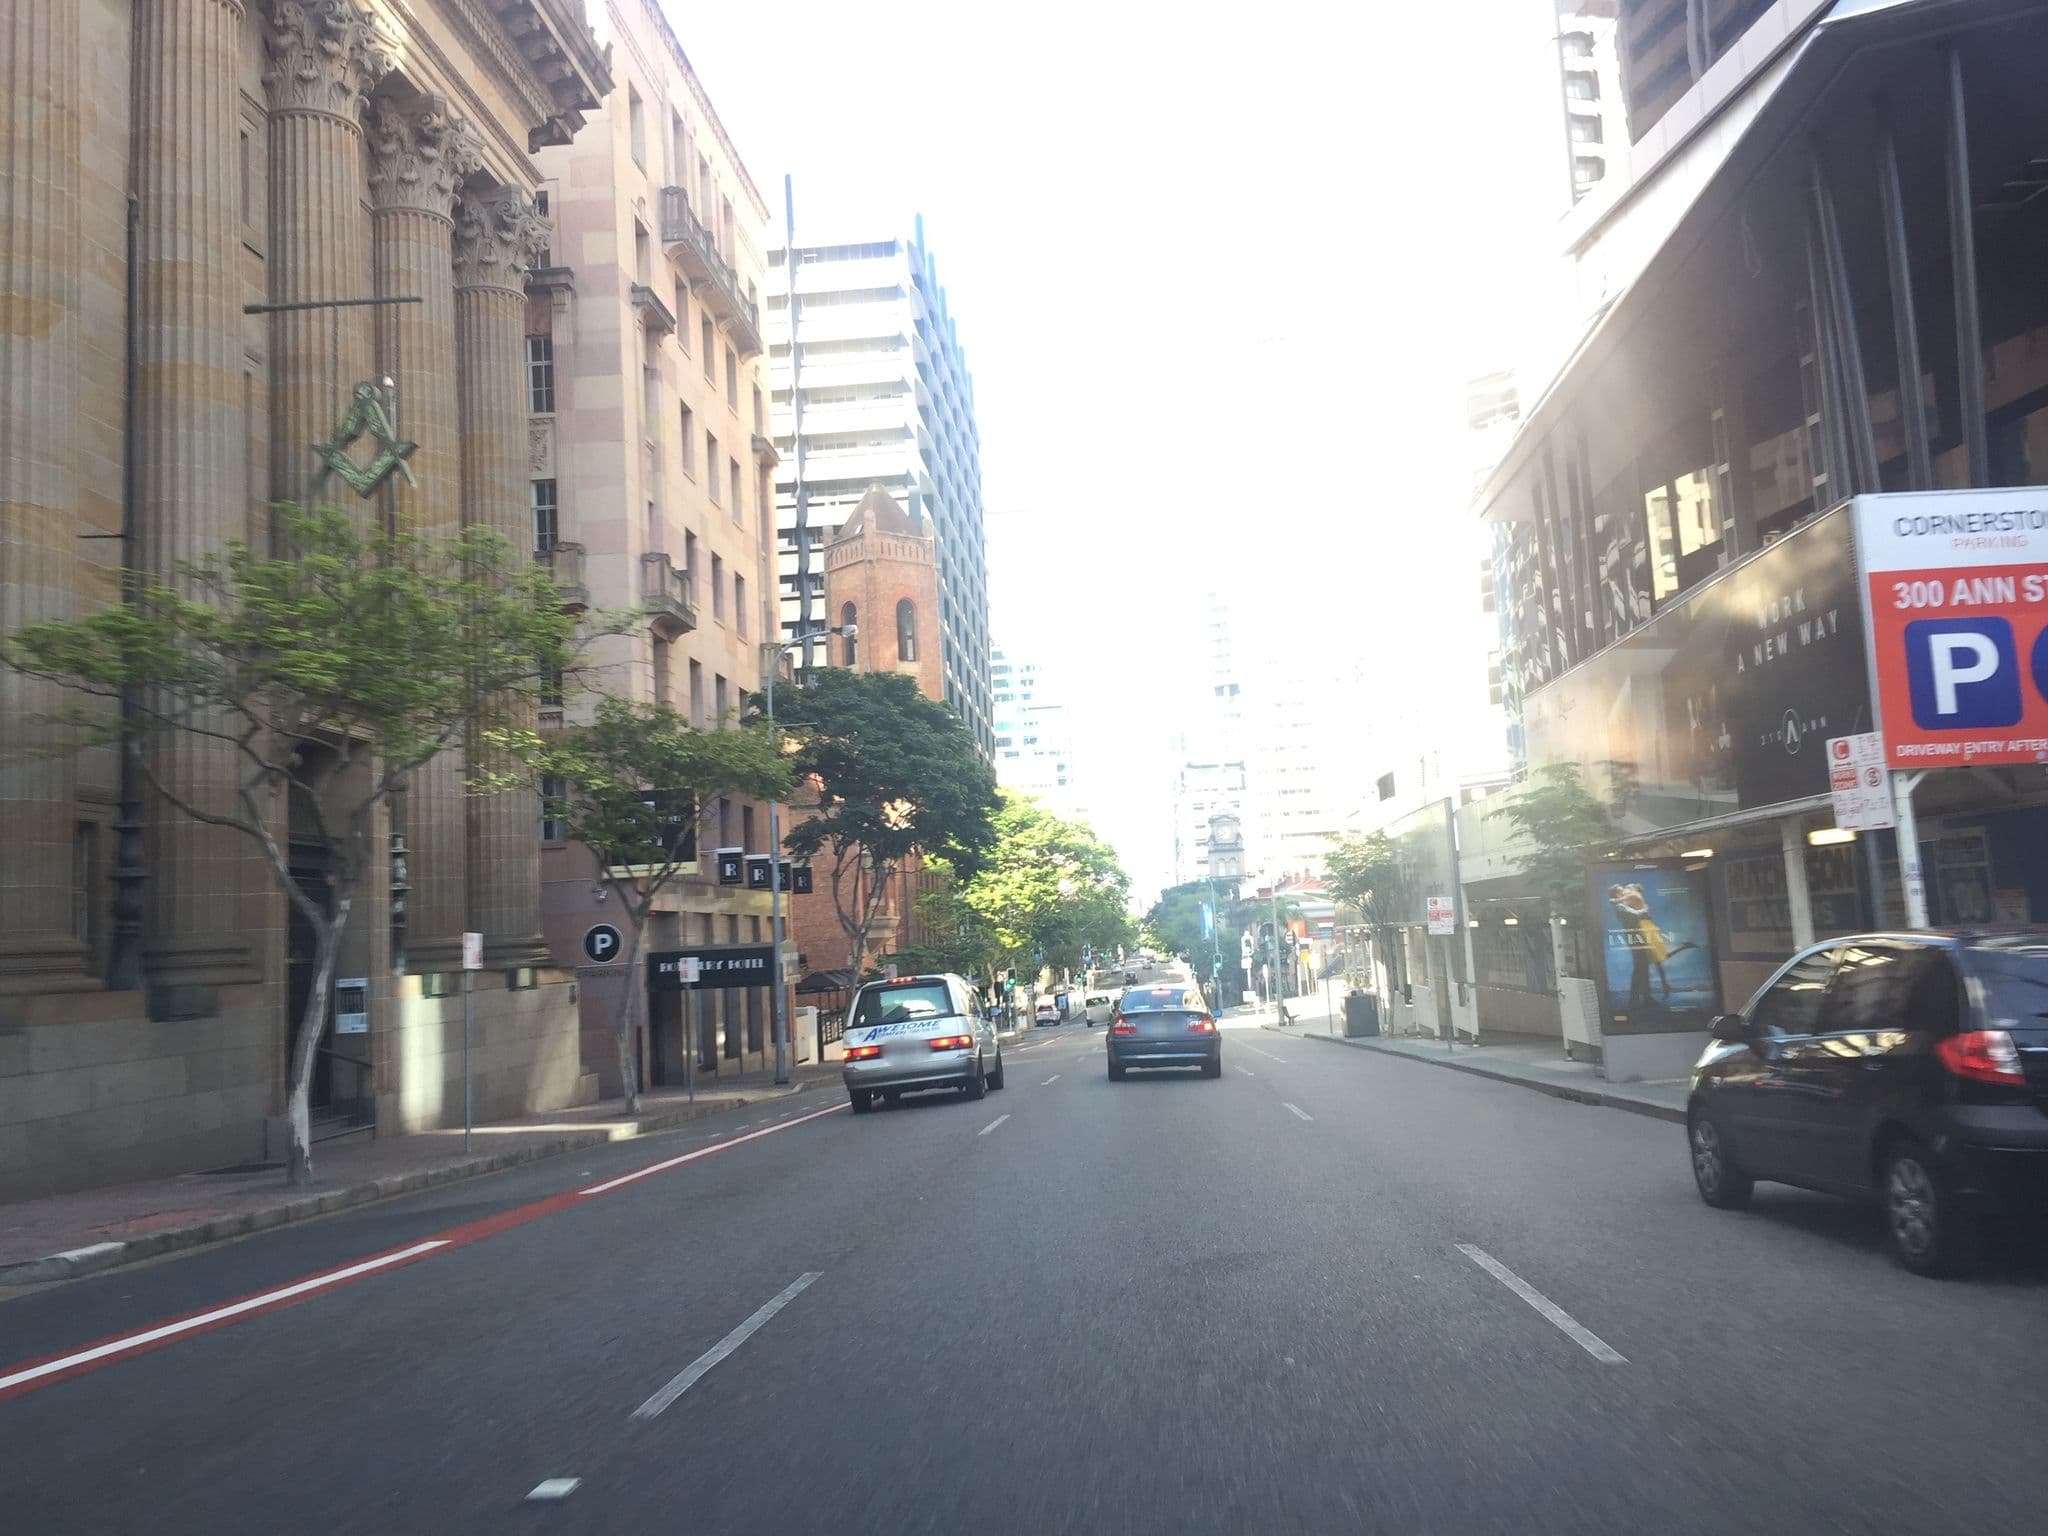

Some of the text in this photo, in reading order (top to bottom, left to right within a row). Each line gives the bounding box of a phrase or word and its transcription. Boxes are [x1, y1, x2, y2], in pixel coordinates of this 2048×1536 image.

[1894, 510, 2048, 537] CORNERSTO
[1952, 535, 2028, 550] PARKING
[1892, 580, 1945, 609] 300
[1951, 576, 2017, 607] ANN
[1758, 587, 1807, 630] WORK
[1737, 609, 1838, 674] A NEW WAY
[1928, 632, 1999, 715] P
[1896, 743, 1961, 757] DRIVEWAY
[1963, 741, 2004, 754] ENTRY
[2006, 738, 2048, 753] AFTER
[724, 863, 737, 877] R
[753, 868, 765, 881] R
[594, 933, 613, 955] P
[863, 1020, 940, 1042] AWESOME
